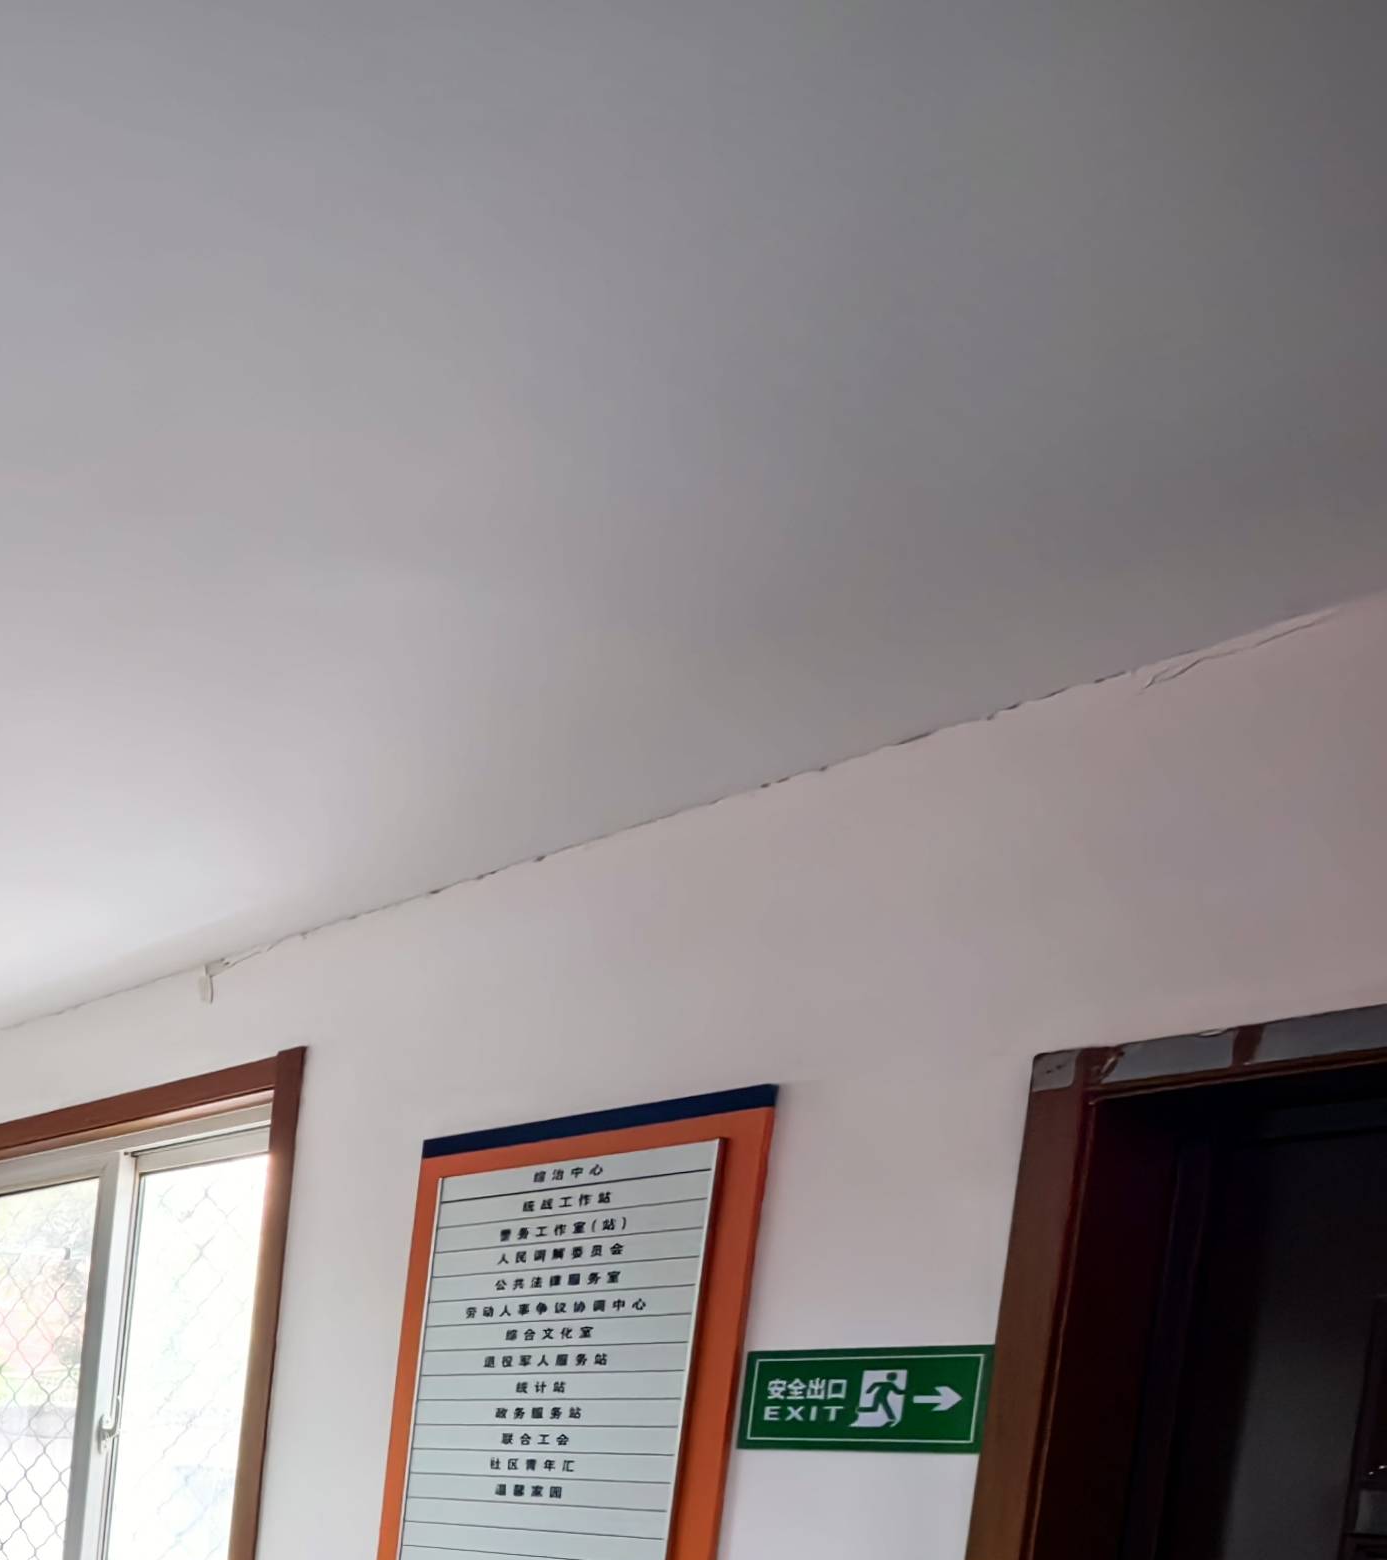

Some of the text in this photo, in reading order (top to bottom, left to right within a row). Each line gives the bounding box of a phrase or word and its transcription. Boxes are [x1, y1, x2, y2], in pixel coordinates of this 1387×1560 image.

[533, 1164, 603, 1183] 综治中心
[523, 1192, 611, 1212] 统战工作站
[497, 1243, 624, 1265] 人民调解委员会
[495, 1270, 621, 1291] 公共法律服务室
[465, 1298, 647, 1319] 劳动人事争议协调中心
[505, 1326, 594, 1342] 综合文化室
[483, 1353, 608, 1368] 退役军人服务站
[516, 1381, 566, 1394] 统计站
[767, 1377, 847, 1400] 安全出口
[495, 1407, 582, 1420] 政务服务站
[763, 1406, 844, 1421] EXIT
[501, 1433, 569, 1446] 联合工会
[490, 1457, 575, 1473] 社区青年汇
[495, 1484, 563, 1499] 温馨家园
